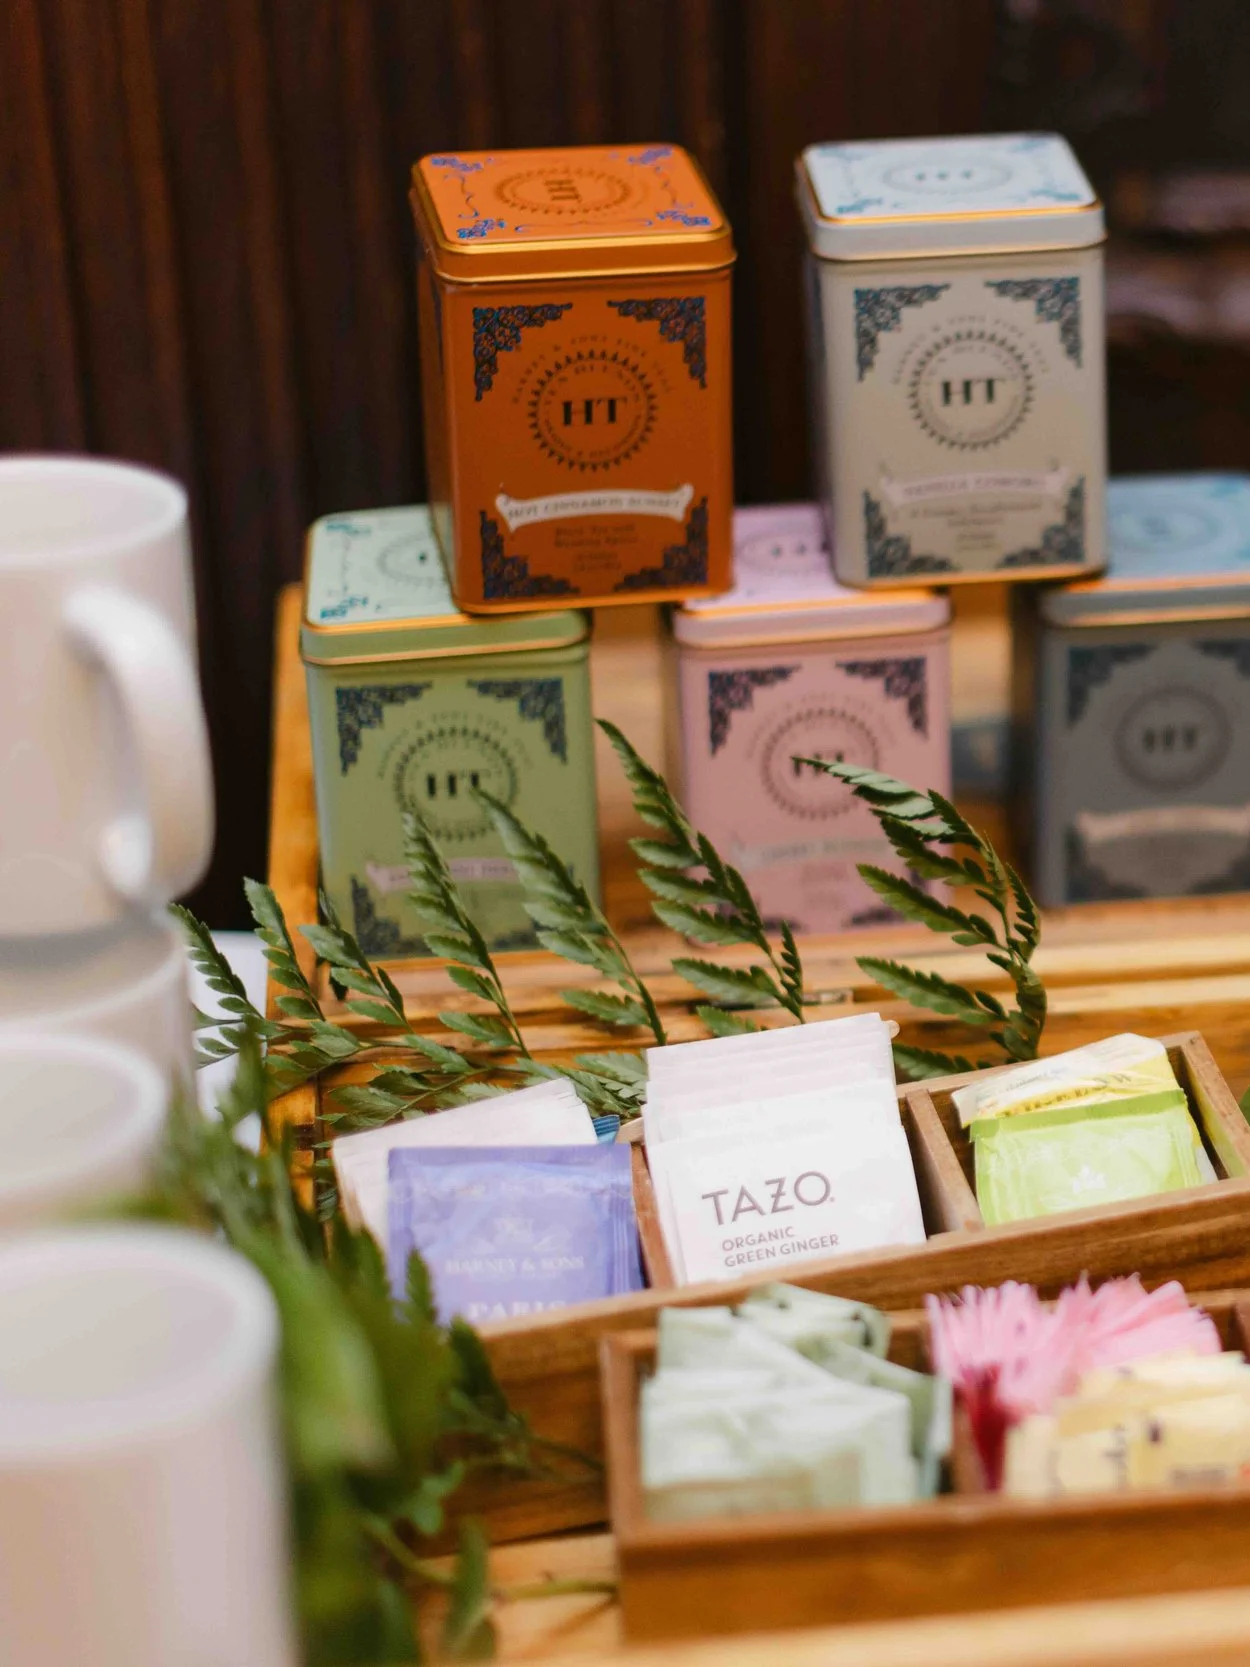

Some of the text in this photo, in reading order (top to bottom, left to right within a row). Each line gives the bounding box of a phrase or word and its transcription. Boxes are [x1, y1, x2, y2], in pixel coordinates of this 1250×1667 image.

[940, 376, 1007, 407] HT
[560, 397, 629, 428] HT
[721, 1225, 796, 1252] ORGANIC
[723, 1233, 840, 1268] GREEN GINGER
